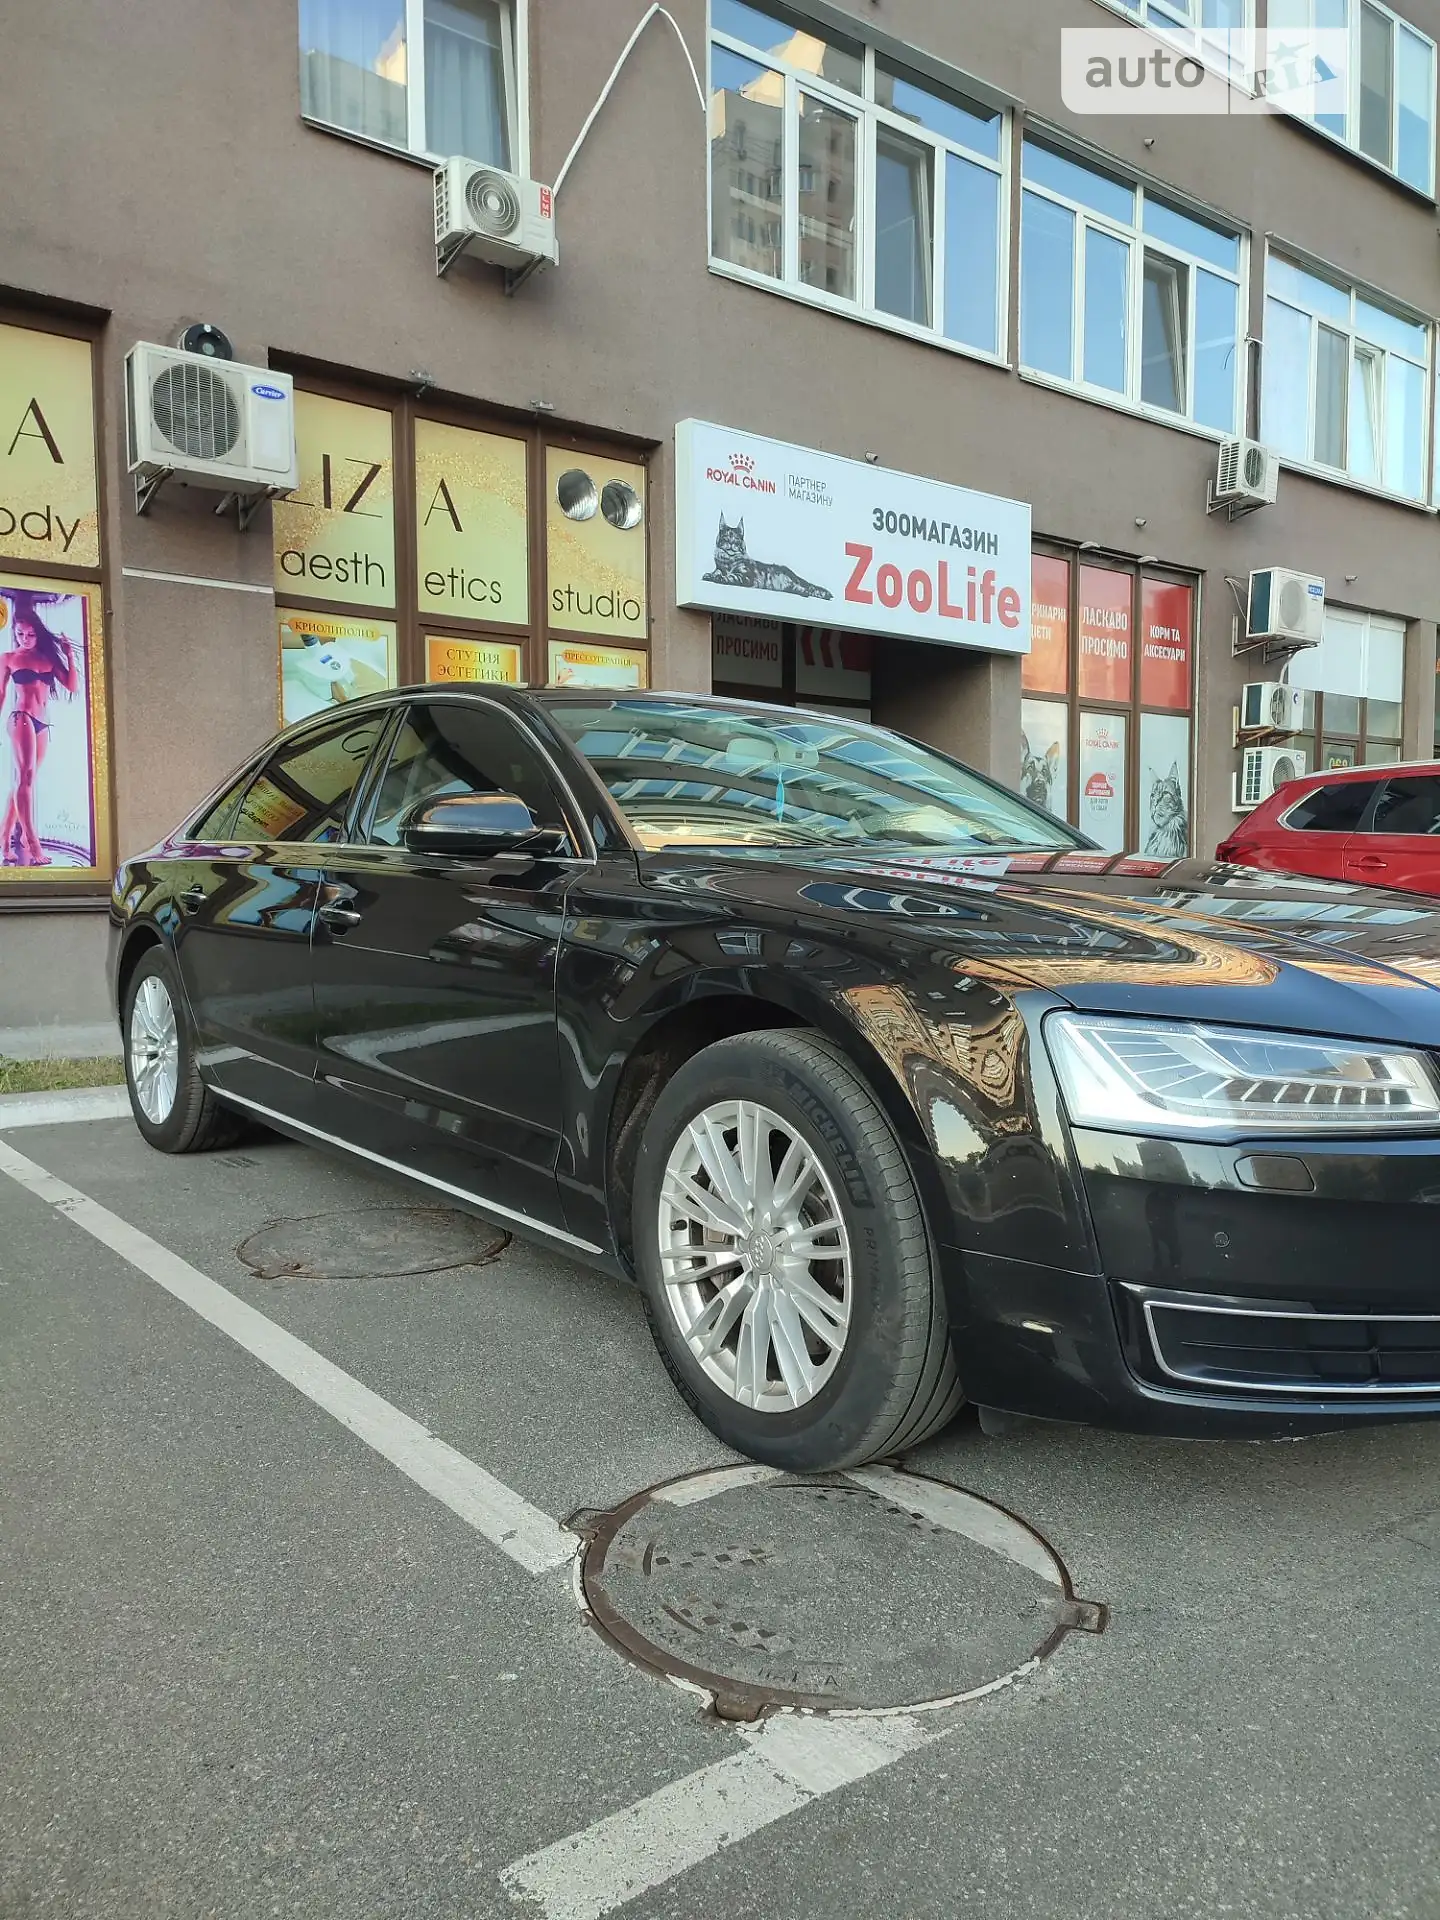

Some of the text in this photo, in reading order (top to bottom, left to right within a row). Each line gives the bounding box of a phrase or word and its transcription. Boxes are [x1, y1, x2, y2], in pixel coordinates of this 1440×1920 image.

[255, 387, 282, 398] Carrier
[7, 397, 64, 465] A
[707, 468, 776, 494] ROYAL CANIN
[788, 474, 827, 492] ПАРТНЕР
[788, 487, 833, 507] МАГАЗИНУ
[872, 507, 998, 556] ЗООМАГАЗИН
[844, 541, 1021, 629] ZooLife
[552, 583, 641, 621] studio
[1031, 602, 1067, 622] РИНАРНІ
[1082, 606, 1128, 632] ЛАСКАВО
[1150, 624, 1181, 643] КОРМ ТА
[446, 648, 500, 665] СТУДИЯ
[716, 635, 779, 662] ПРОСИМО
[1081, 636, 1128, 660] ПРОСИМО
[1144, 644, 1186, 663] АКСЕСУАРИ
[437, 664, 509, 682] ЭСТЕТИКИ
[788, 1081, 873, 1205] MICHELIN
